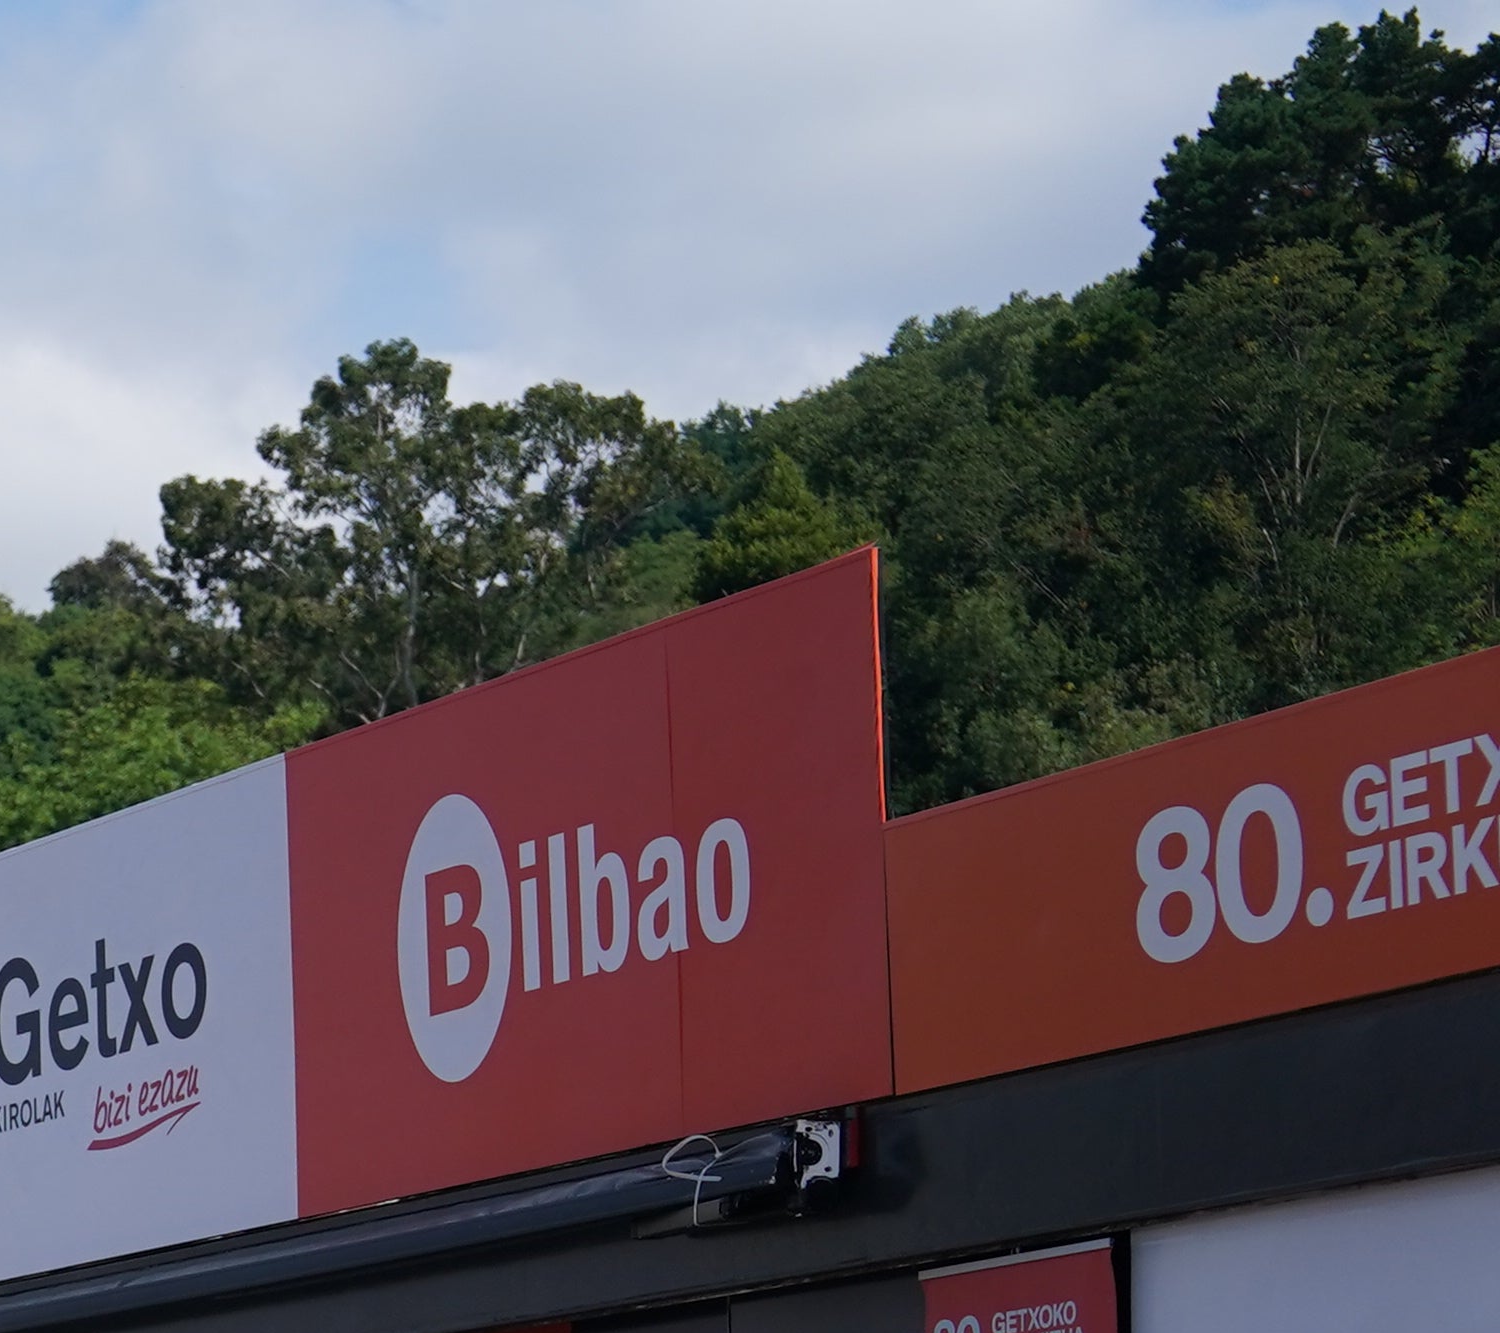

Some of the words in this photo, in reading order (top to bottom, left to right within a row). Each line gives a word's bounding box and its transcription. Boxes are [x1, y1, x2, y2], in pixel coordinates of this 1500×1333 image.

[424, 818, 751, 1017] Bilbao
[1134, 783, 1334, 963] 80.
[1346, 812, 1500, 920] ZIRK
[93, 1083, 132, 1133] bizi
[138, 1065, 199, 1116] ezazu
